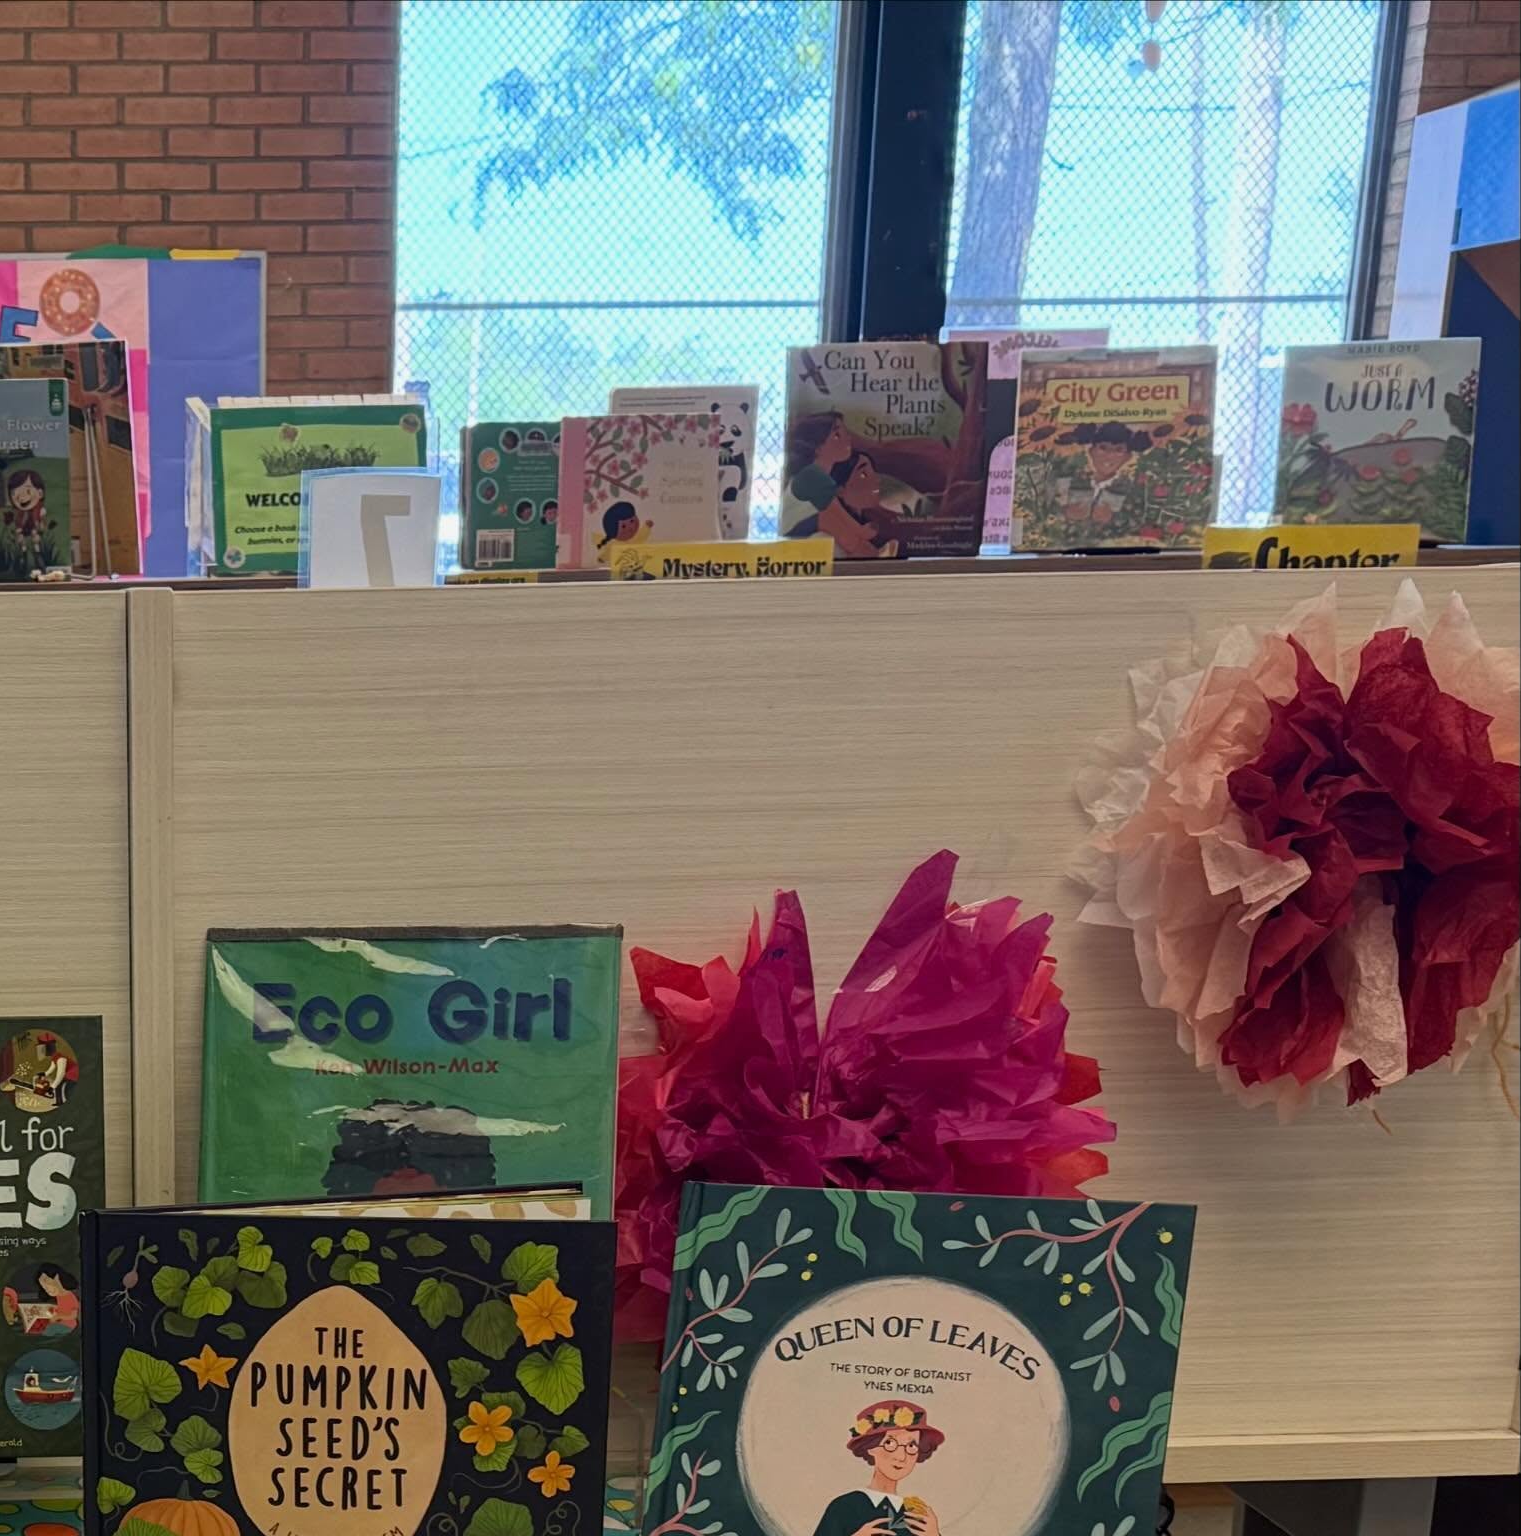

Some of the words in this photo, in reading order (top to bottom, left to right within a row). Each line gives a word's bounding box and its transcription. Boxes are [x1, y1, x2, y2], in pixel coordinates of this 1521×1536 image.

[824, 350, 866, 370] Can
[874, 350, 915, 370] You
[1361, 363, 1391, 378] JUST
[850, 372, 902, 392] Hear
[908, 372, 941, 392] the
[886, 394, 946, 414] Plants
[1054, 382, 1101, 407] City
[1107, 383, 1179, 401] Green
[1325, 376, 1436, 413] WORM
[7, 418, 63, 432] Flower
[864, 417, 936, 440] Speak?
[662, 557, 750, 580] Mystery,
[757, 556, 828, 578] Horror
[253, 982, 394, 1044] Eco
[428, 978, 572, 1044] Girl
[314, 1058, 355, 1075] Ken
[363, 1058, 499, 1075] Wilson-Max
[21, 1116, 74, 1151] for
[21, 1237, 47, 1248] ways
[314, 1326, 365, 1359] THE
[775, 1316, 876, 1362] QUEEN
[882, 1316, 924, 1339] OF
[929, 1320, 1041, 1381] LEAVES
[830, 1362, 852, 1374] THE
[854, 1364, 893, 1377] STORY
[895, 1367, 911, 1378] OF
[913, 1368, 973, 1383] BOTANIST
[249, 1361, 429, 1412] PUMPKIN
[863, 1380, 894, 1393] YNES
[895, 1383, 935, 1395] MEXIA
[275, 1416, 401, 1462] SEED'S
[267, 1466, 408, 1511] SECRET
[269, 1522, 280, 1536] A
